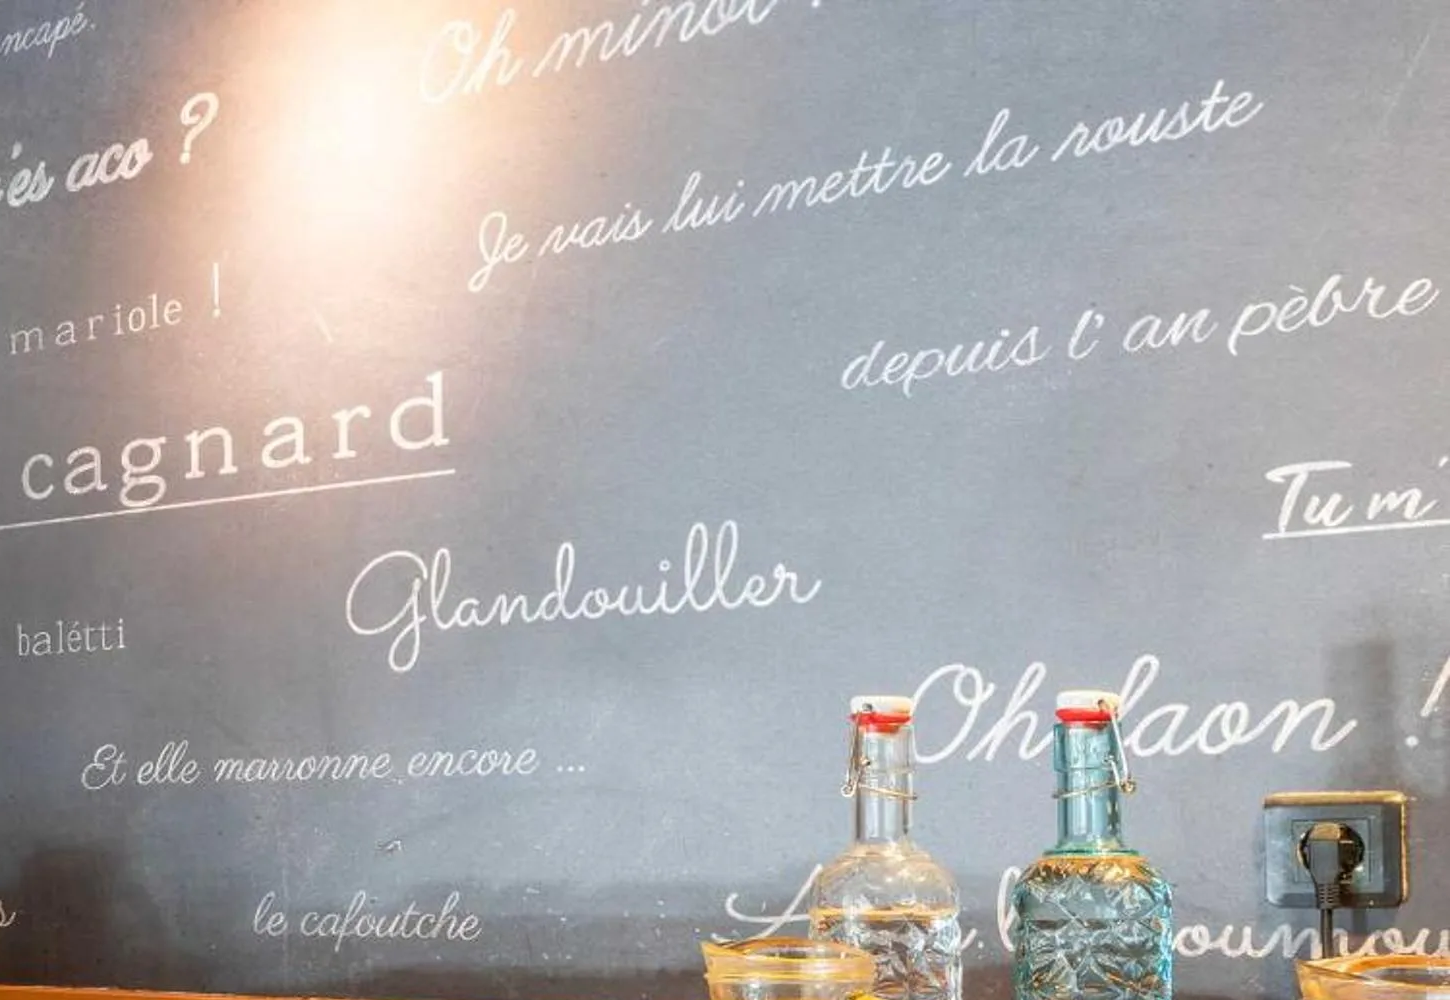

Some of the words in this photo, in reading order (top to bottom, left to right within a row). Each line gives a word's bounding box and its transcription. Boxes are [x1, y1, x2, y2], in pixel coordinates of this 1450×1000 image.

[417, 8, 523, 100] Oh
[66, 137, 153, 192] aco
[180, 92, 220, 164] ?
[467, 211, 529, 292] Je
[539, 202, 653, 257] vais
[662, 171, 747, 233] lui
[753, 146, 952, 217] mettre
[965, 108, 1040, 177] la
[1051, 80, 1265, 161] rouste
[10, 293, 183, 354] mariole
[211, 262, 221, 318] !
[842, 327, 1052, 398] depuis
[1122, 306, 1219, 351] an
[1227, 273, 1440, 356] pèbre
[22, 372, 449, 508] cagnard
[1265, 460, 1354, 533] Tu
[346, 520, 822, 673] Glandouiller
[913, 662, 1052, 764] Oh
[81, 744, 127, 790] Et
[137, 740, 200, 786] elle
[214, 751, 392, 783] marronne
[407, 747, 541, 777] encore
[252, 890, 288, 936] le
[300, 890, 483, 952] cafoutche
